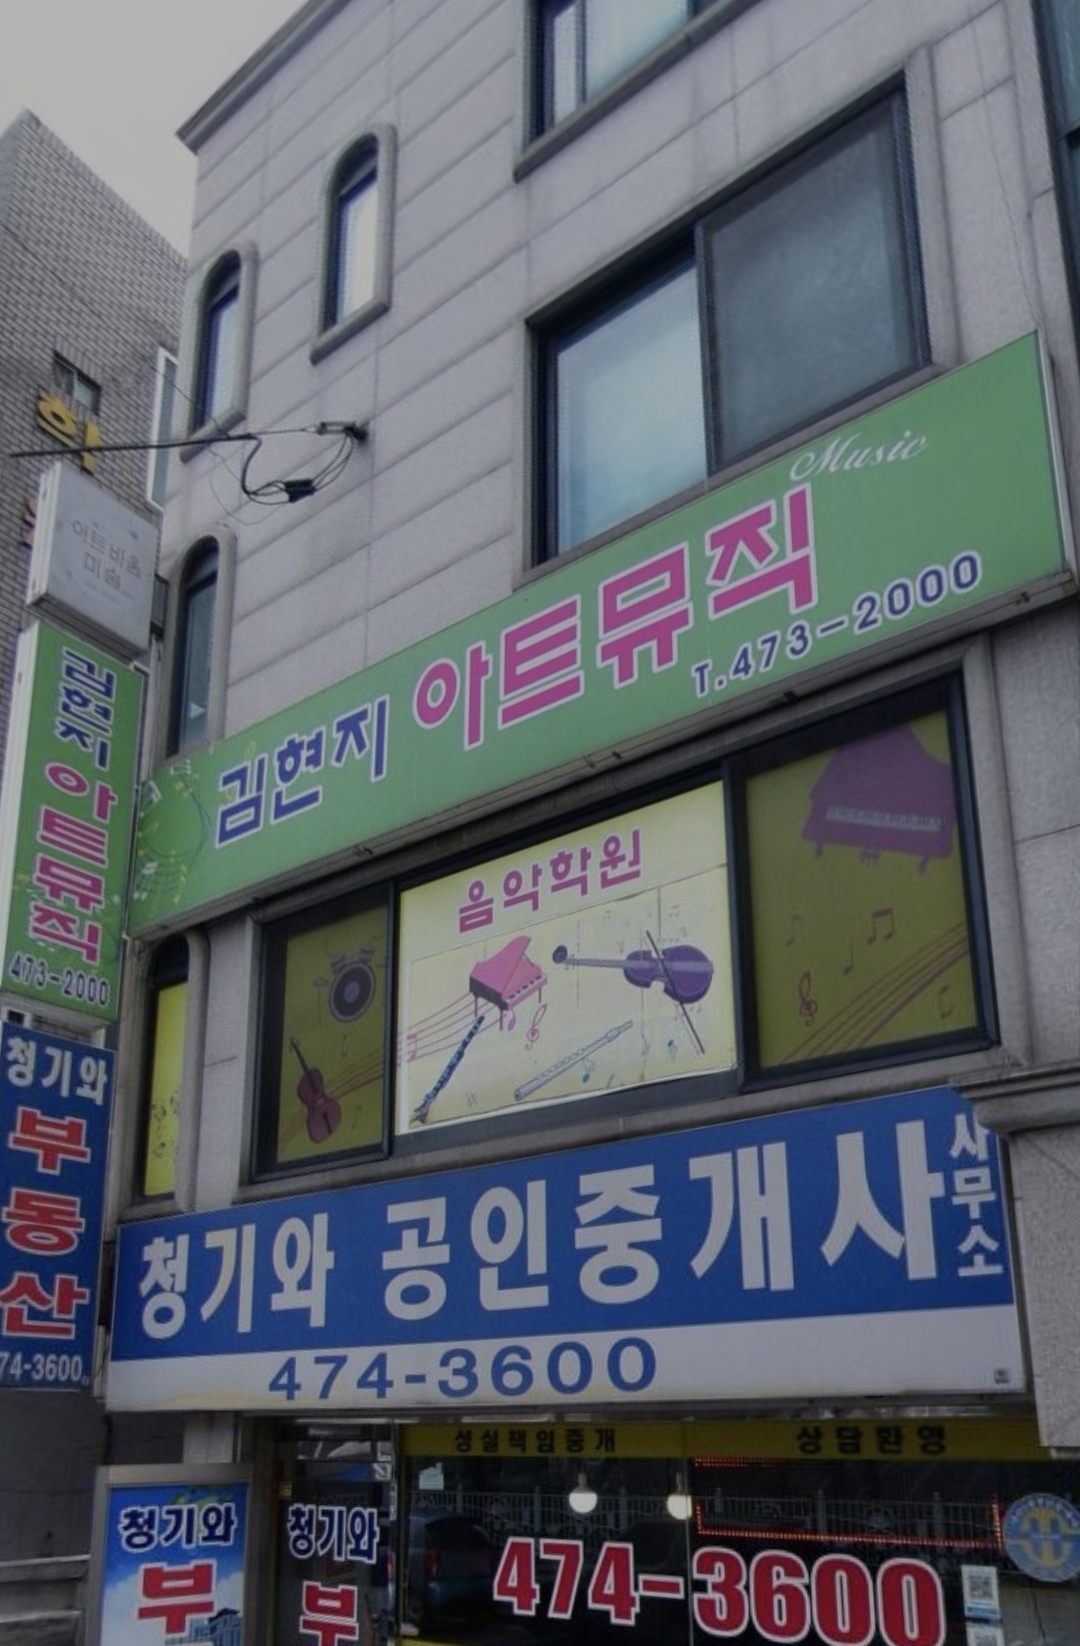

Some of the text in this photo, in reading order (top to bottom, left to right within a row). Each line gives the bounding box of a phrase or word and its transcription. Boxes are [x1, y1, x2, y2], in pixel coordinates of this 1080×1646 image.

[789, 429, 930, 481] Music
[215, 482, 818, 848] 김현지 아트뮤직
[692, 549, 983, 698] T.473-2000
[55, 645, 118, 773] 김현지
[28, 760, 119, 966] 아트뮤직
[457, 827, 642, 935] 음악학원
[8, 952, 111, 1006] 473-2000
[6, 1036, 109, 1106] 청기와
[0, 1105, 92, 1340] 부동산
[139, 1119, 945, 1340] 청기와 공인중개사
[950, 1113, 1004, 1277] 사무소
[268, 1336, 657, 1401] 474-3600
[120, 1502, 238, 1554] 청기와
[287, 1503, 380, 1565] 청기와
[136, 1558, 217, 1638] 부
[300, 1580, 360, 1646] 부
[493, 1535, 947, 1646] 474-3600
